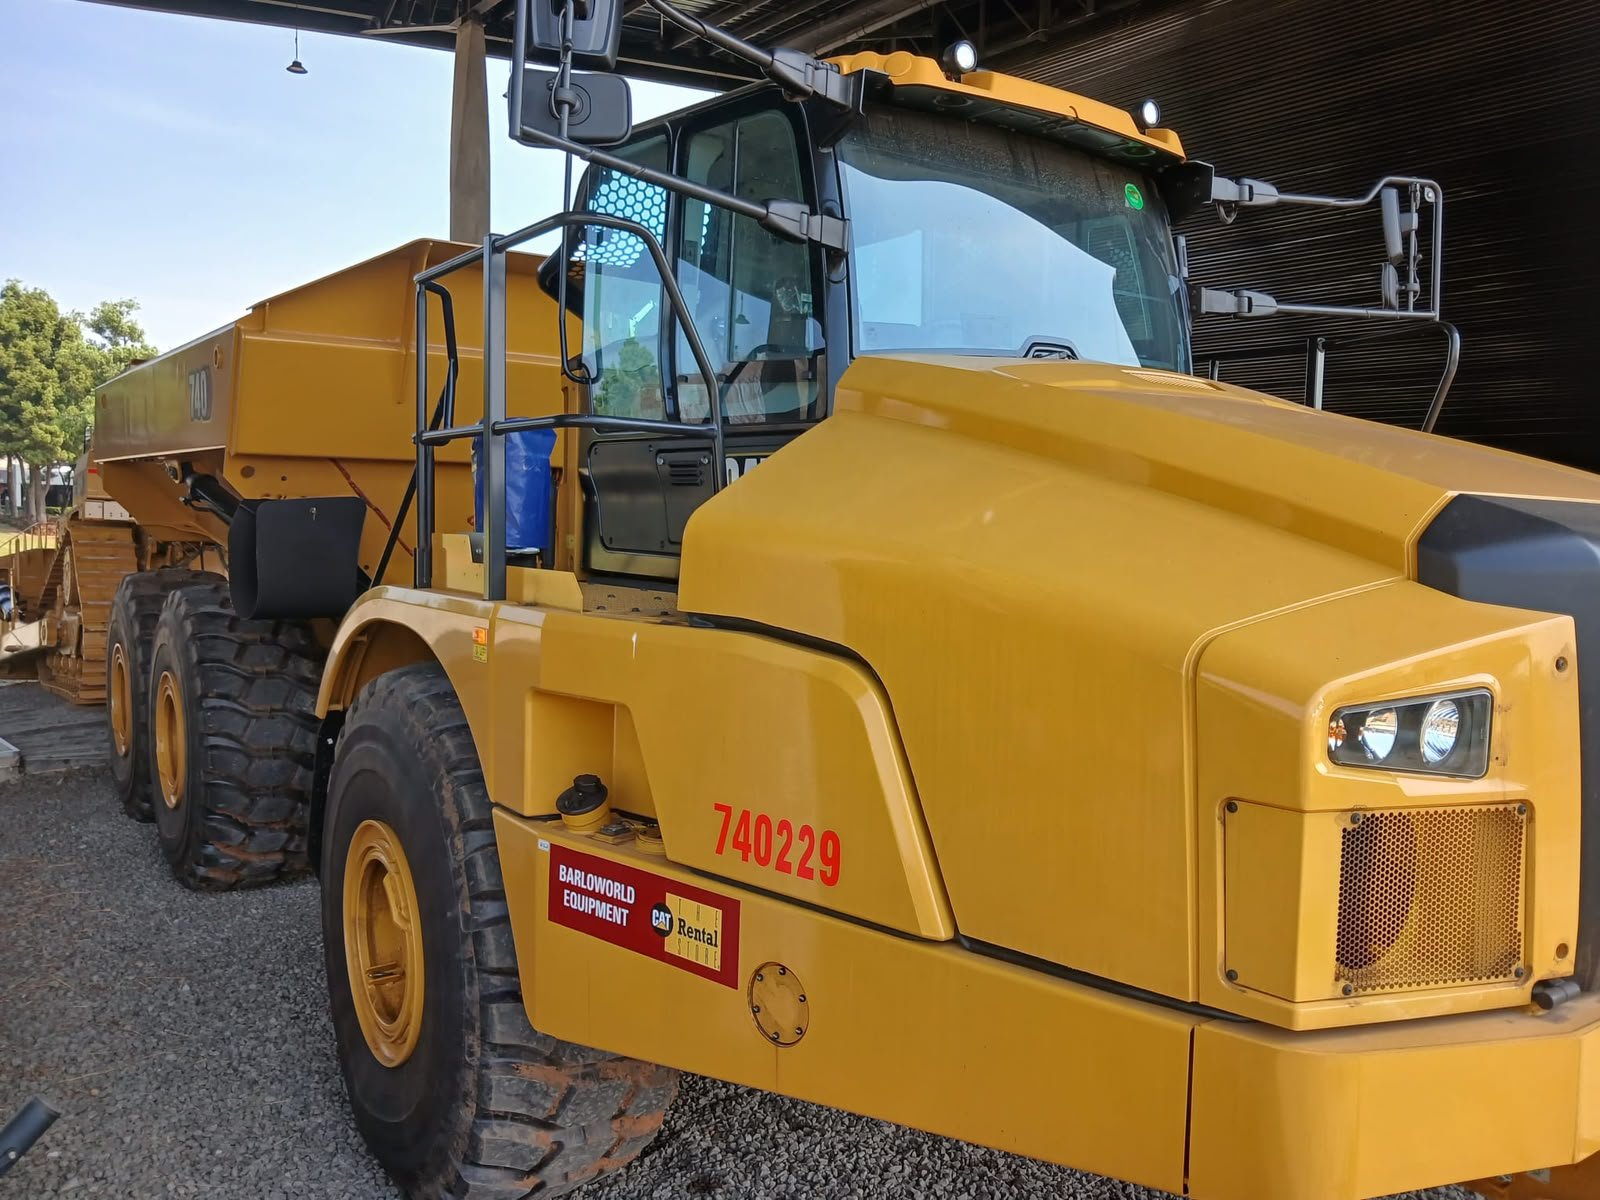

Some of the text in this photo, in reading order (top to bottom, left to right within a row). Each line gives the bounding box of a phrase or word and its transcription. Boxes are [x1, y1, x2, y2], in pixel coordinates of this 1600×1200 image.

[189, 369, 208, 417] 740
[713, 802, 841, 887] 740229
[559, 864, 636, 904] BARLOWORLD
[563, 889, 629, 927] EQUIPMENT
[651, 909, 671, 931] CAT
[677, 917, 719, 948] Rental
